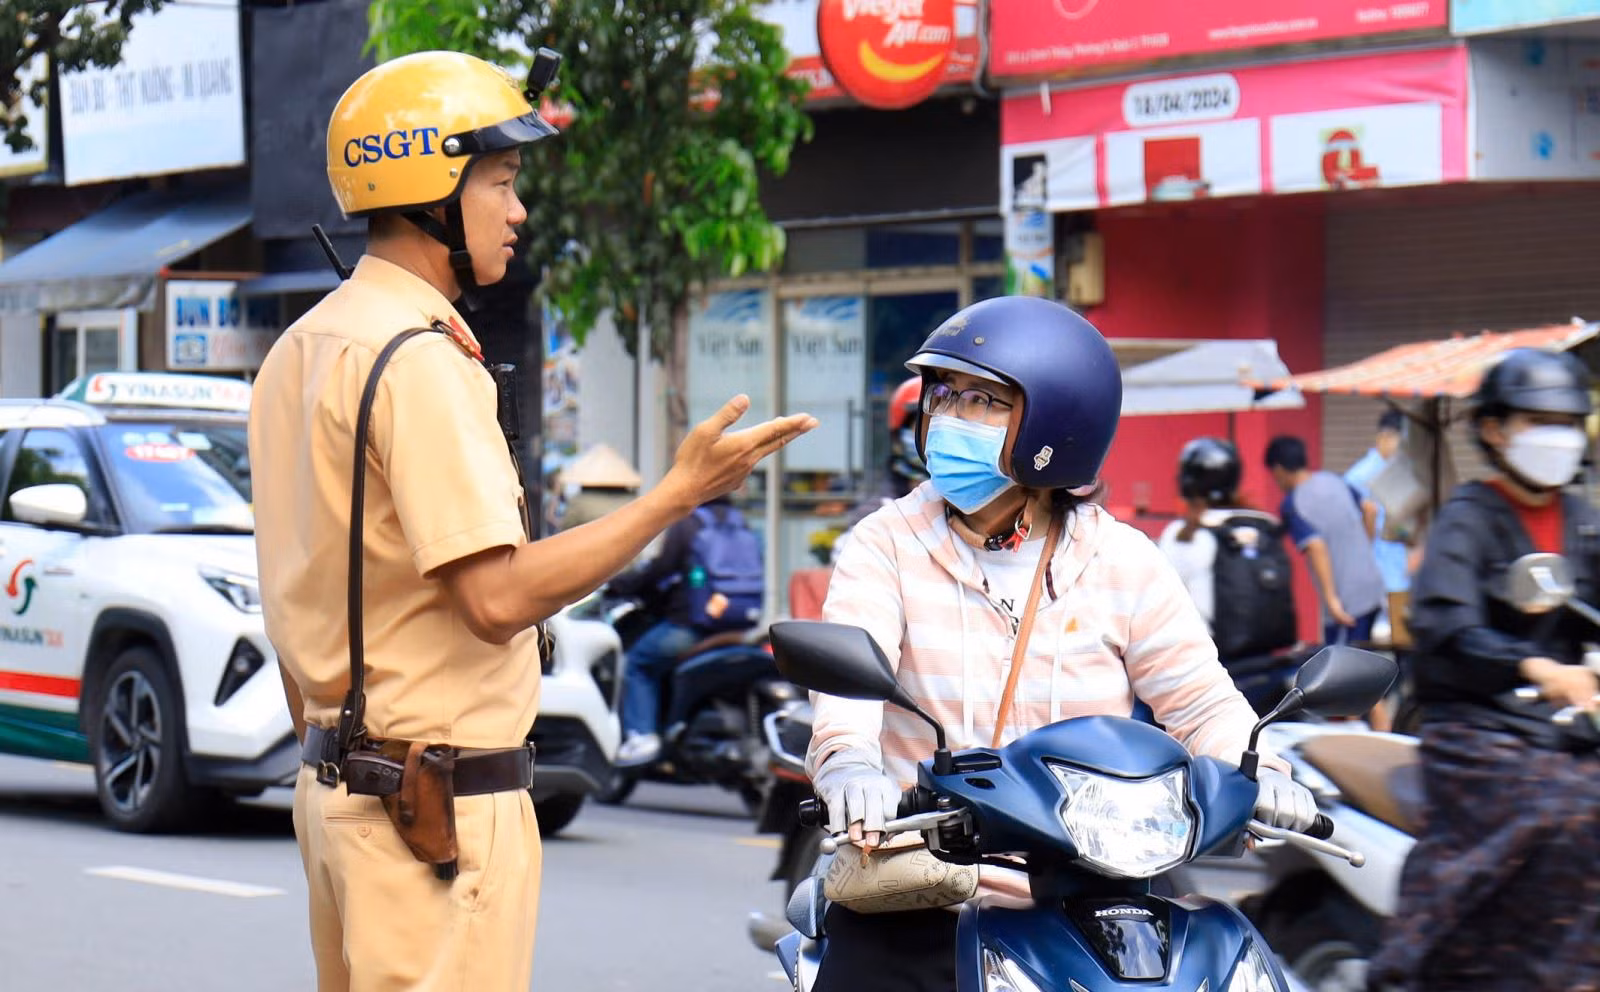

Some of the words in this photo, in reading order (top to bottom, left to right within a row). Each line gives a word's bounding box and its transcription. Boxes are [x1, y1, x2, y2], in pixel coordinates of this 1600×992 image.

[1134, 86, 1231, 116] 18/04/2024
[344, 127, 439, 167] CSGT
[1095, 908, 1154, 917] HONDA
